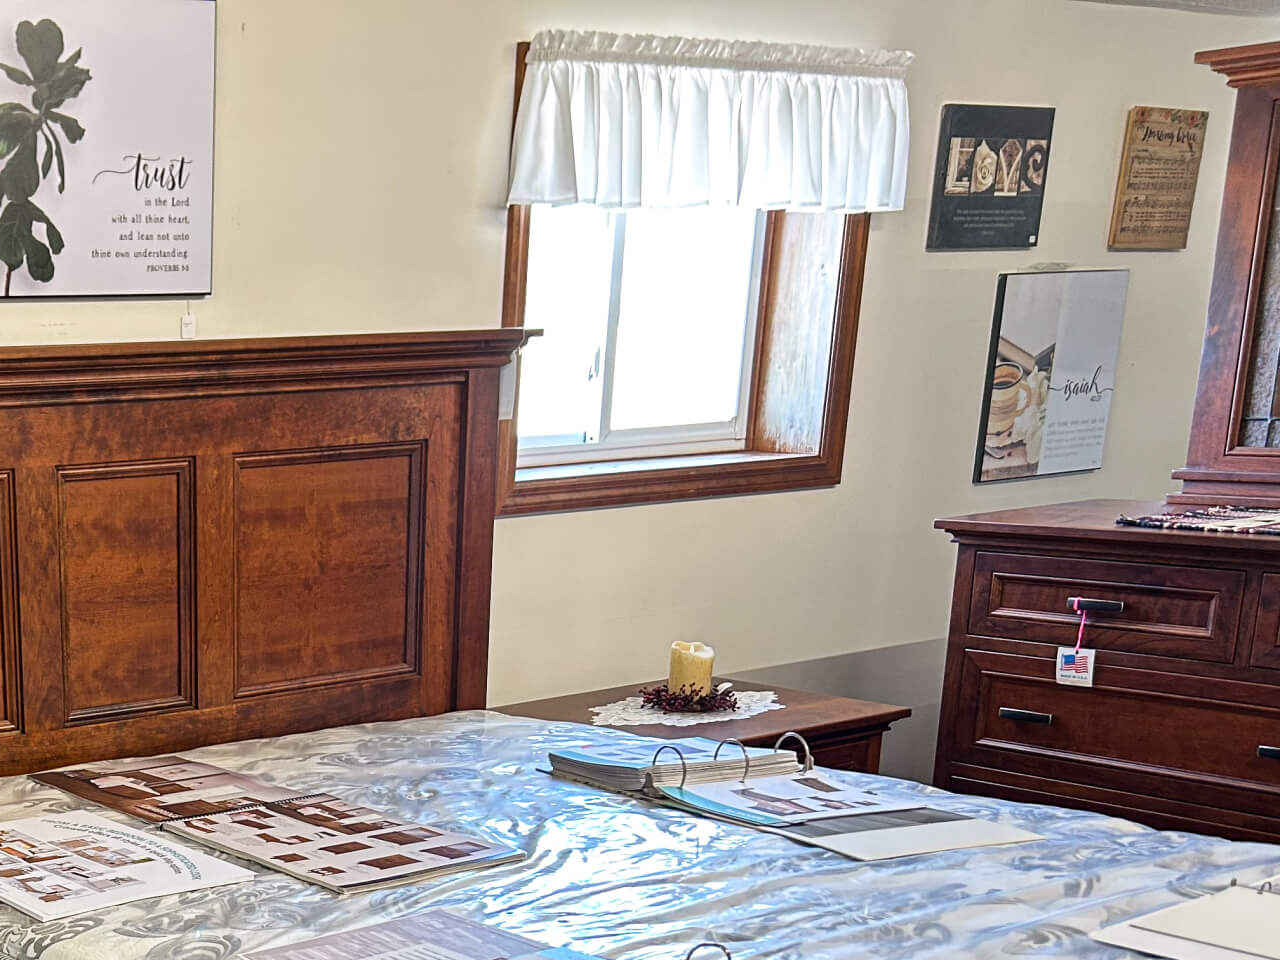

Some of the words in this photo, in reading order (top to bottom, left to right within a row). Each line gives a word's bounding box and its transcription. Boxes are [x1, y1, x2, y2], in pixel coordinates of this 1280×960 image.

[92, 153, 193, 192] trust
[144, 197, 151, 206] in
[155, 197, 167, 206] the
[111, 214, 128, 224] with
[131, 214, 142, 223] all
[145, 214, 165, 224] thine
[119, 231, 133, 241] and
[137, 231, 154, 241] lean
[157, 231, 170, 241] not
[173, 232, 190, 241] unto
[91, 249, 111, 258] thine
[133, 248, 188, 259] understanding
[1048, 365, 1114, 401] isaiah
